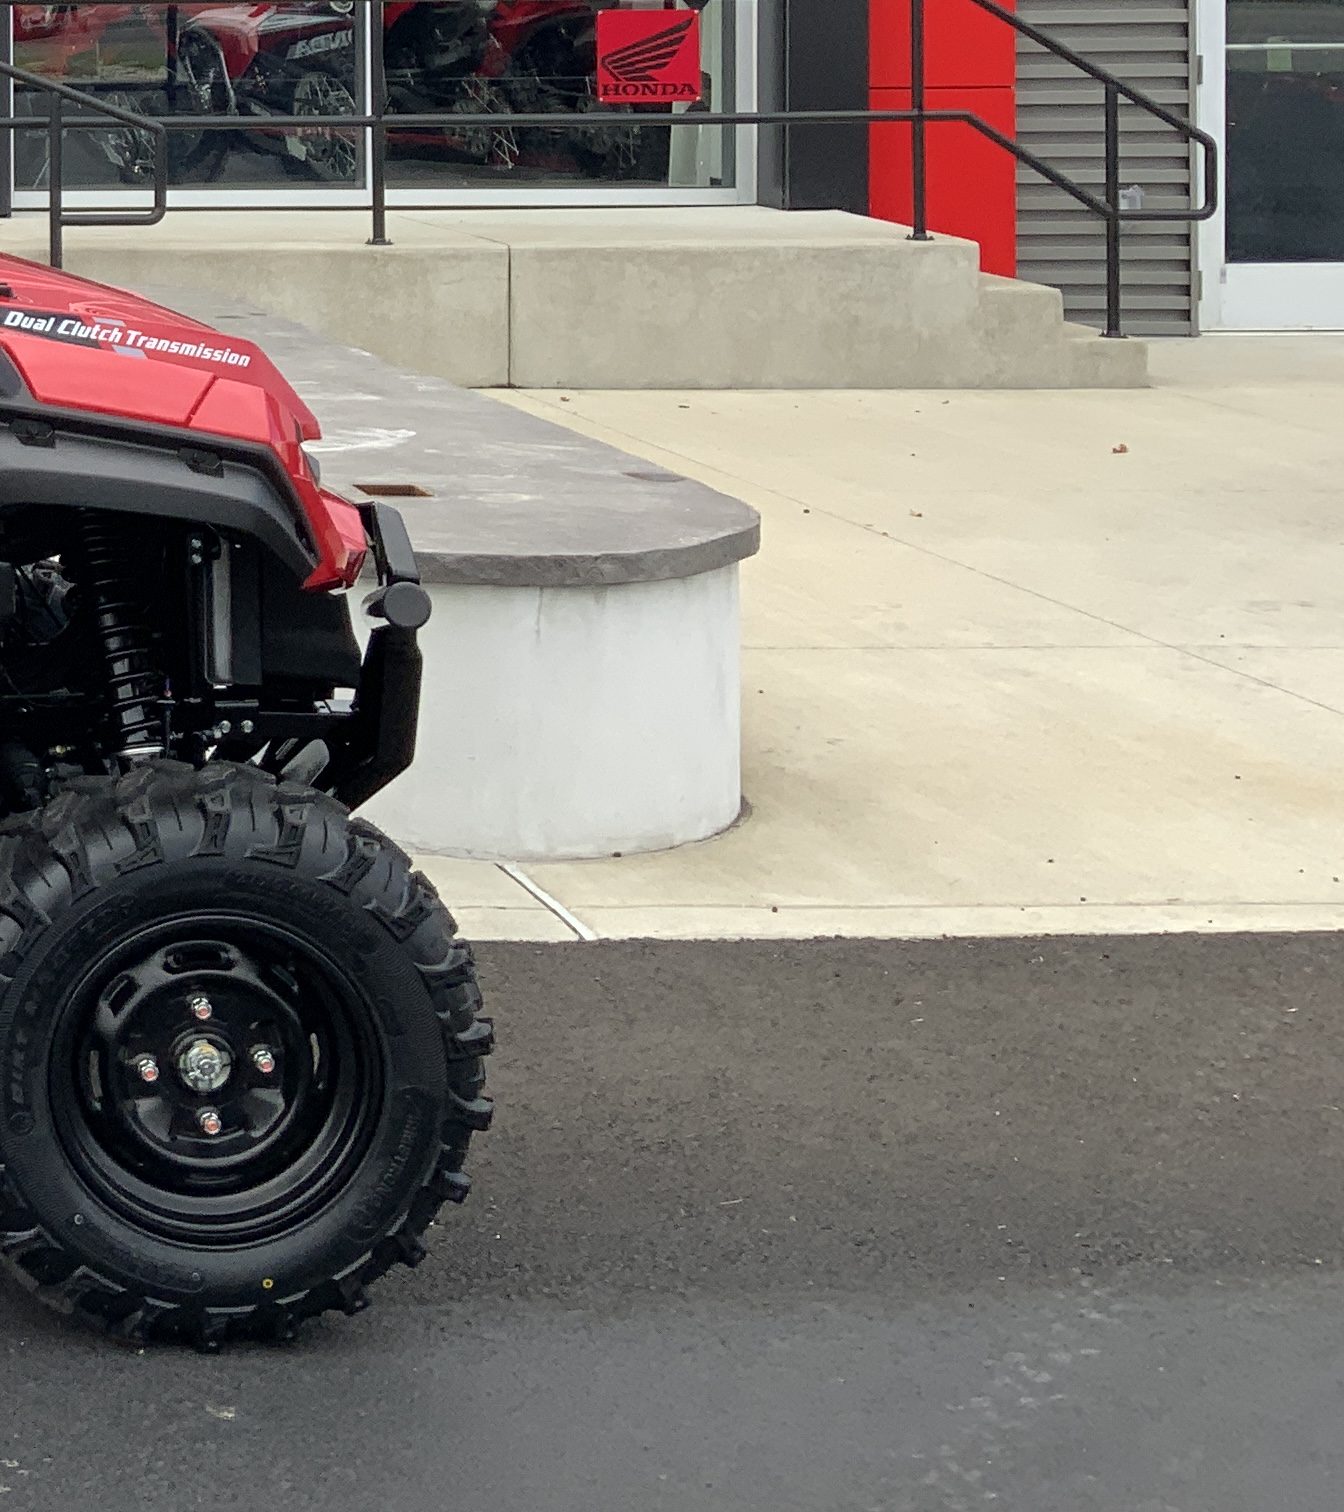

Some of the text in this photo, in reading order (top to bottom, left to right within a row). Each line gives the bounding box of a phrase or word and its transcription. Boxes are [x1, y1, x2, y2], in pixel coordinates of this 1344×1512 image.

[602, 83, 699, 95] HONDA
[4, 311, 251, 367] Dual Clutch Transmission
